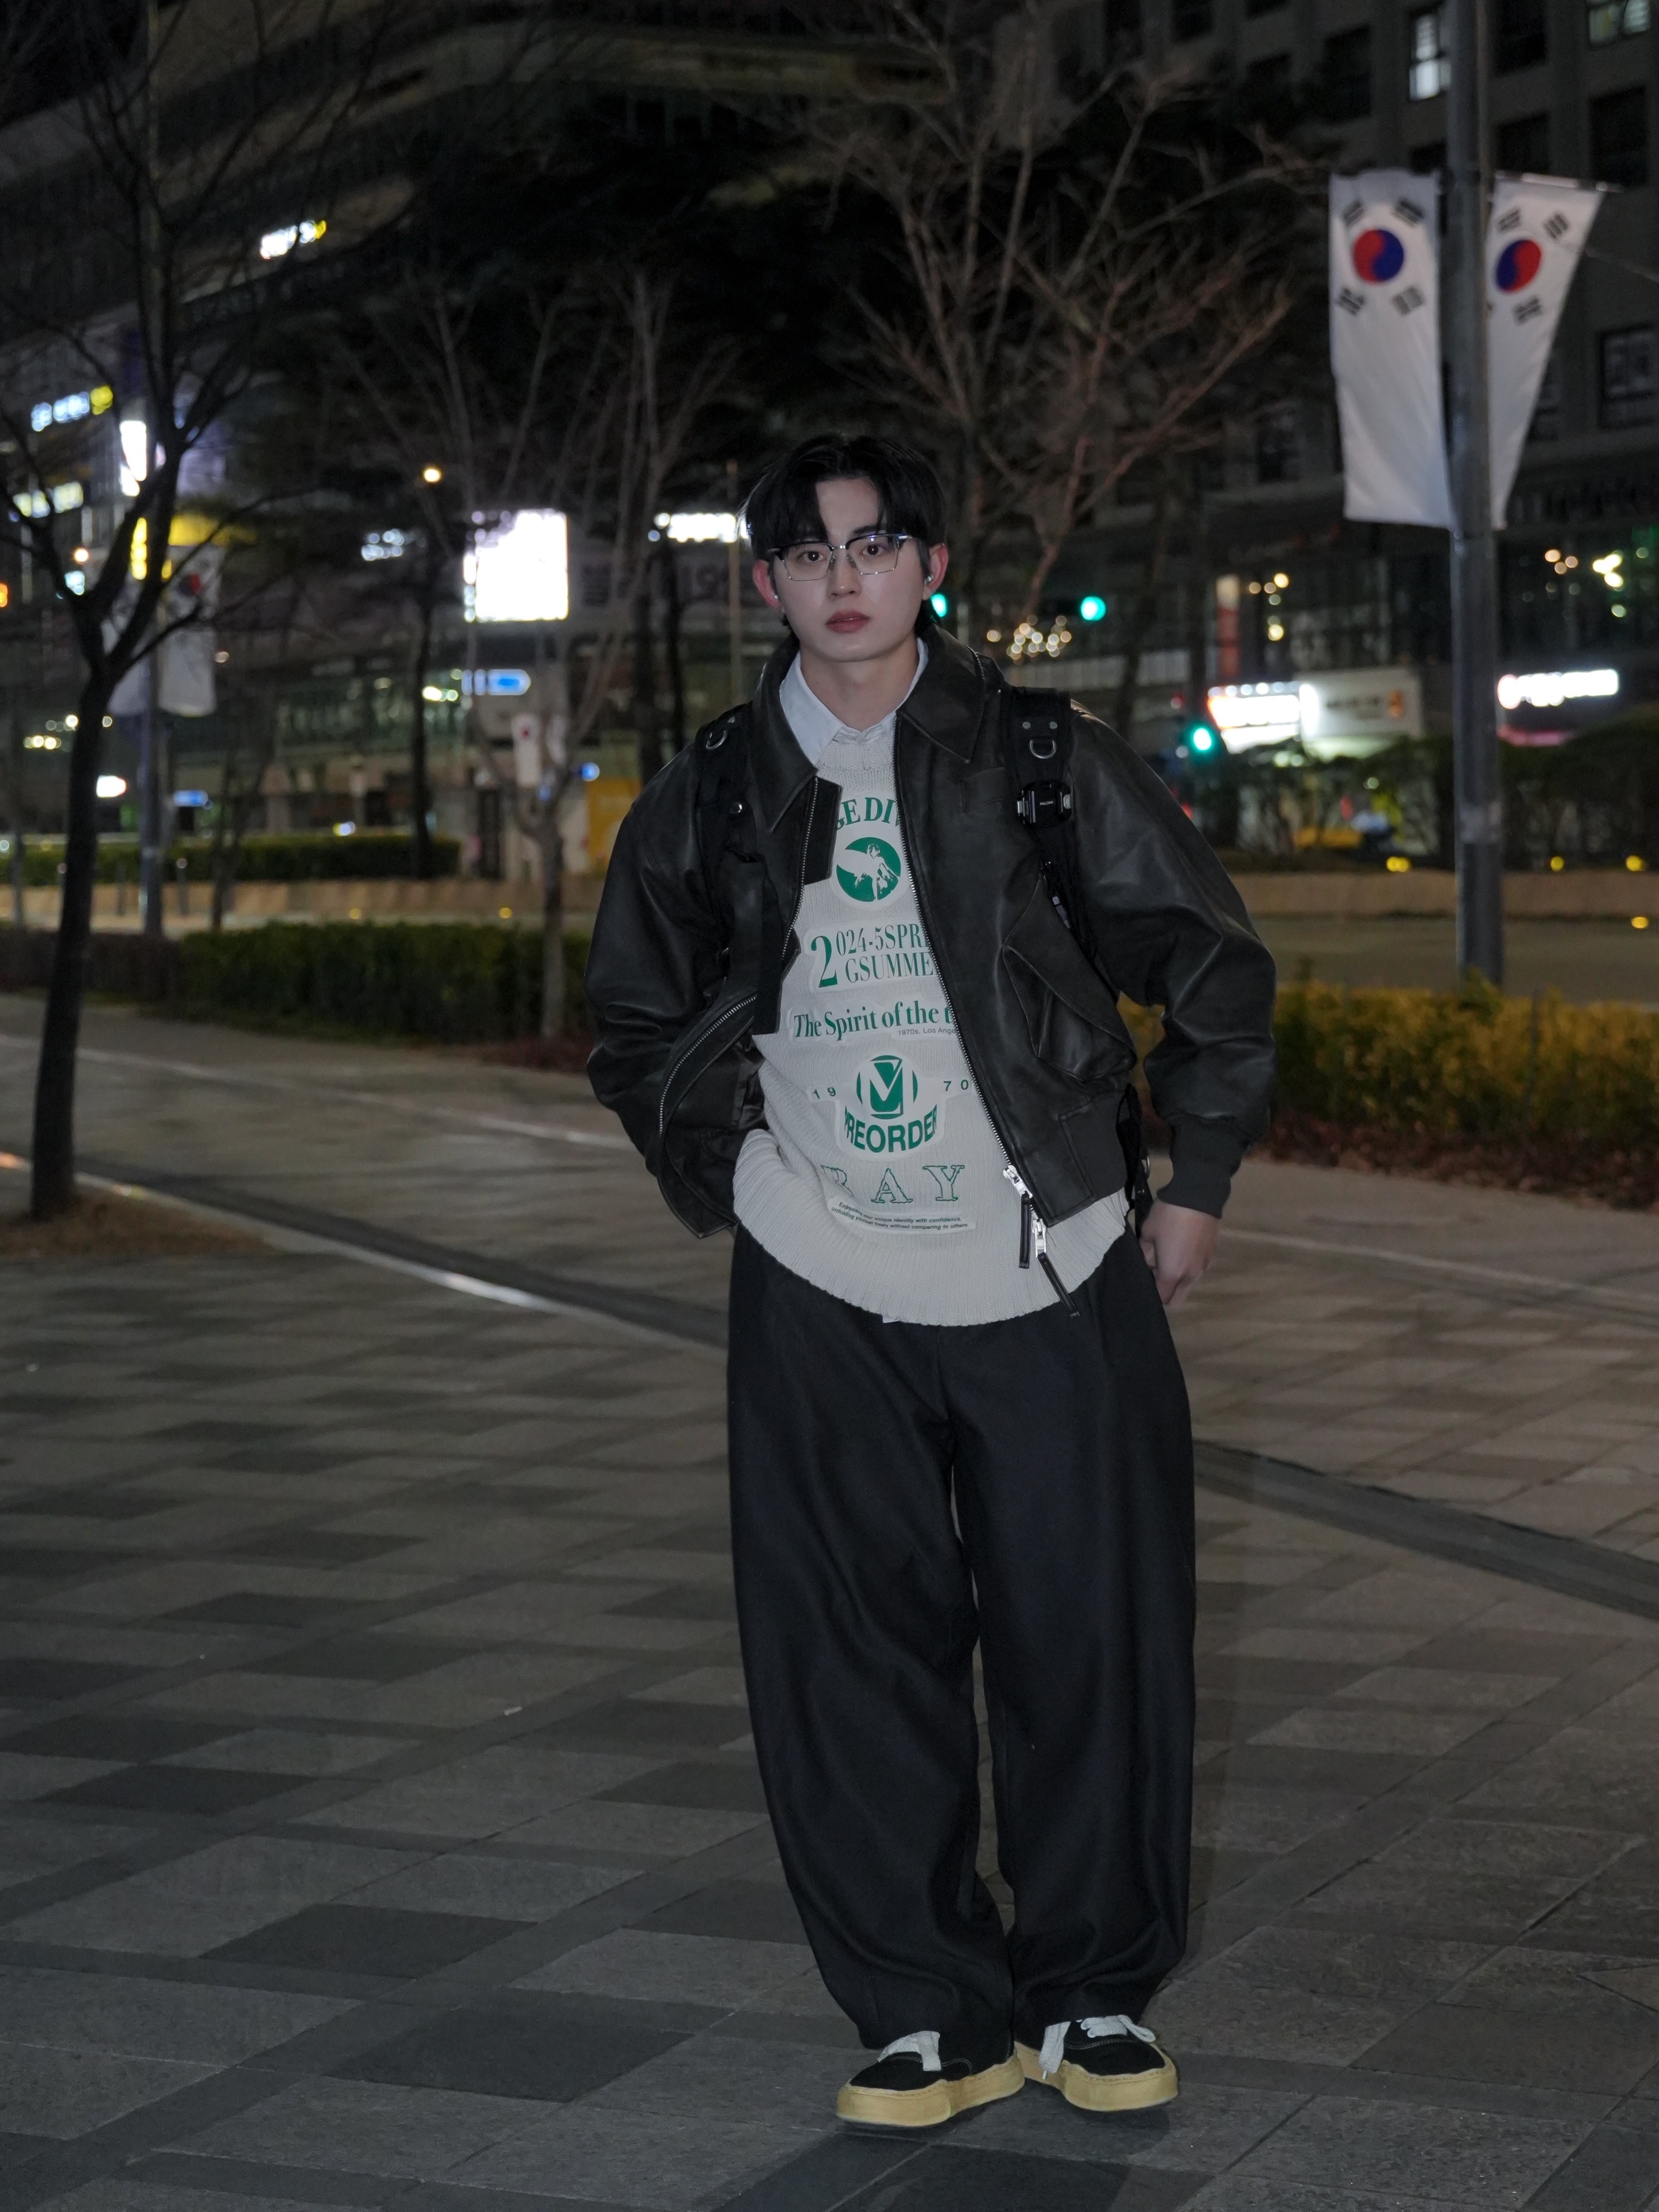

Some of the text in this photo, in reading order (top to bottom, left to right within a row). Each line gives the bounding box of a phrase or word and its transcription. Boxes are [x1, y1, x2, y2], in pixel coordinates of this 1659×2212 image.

[845, 952, 938, 983] GSUMME
[794, 1013, 822, 1037] The
[825, 1006, 879, 1041] Spirit
[881, 1001, 903, 1028] of
[905, 1000, 940, 1024] the
[844, 1104, 937, 1153] PREORDER
[831, 1207, 855, 1220] unfolding
